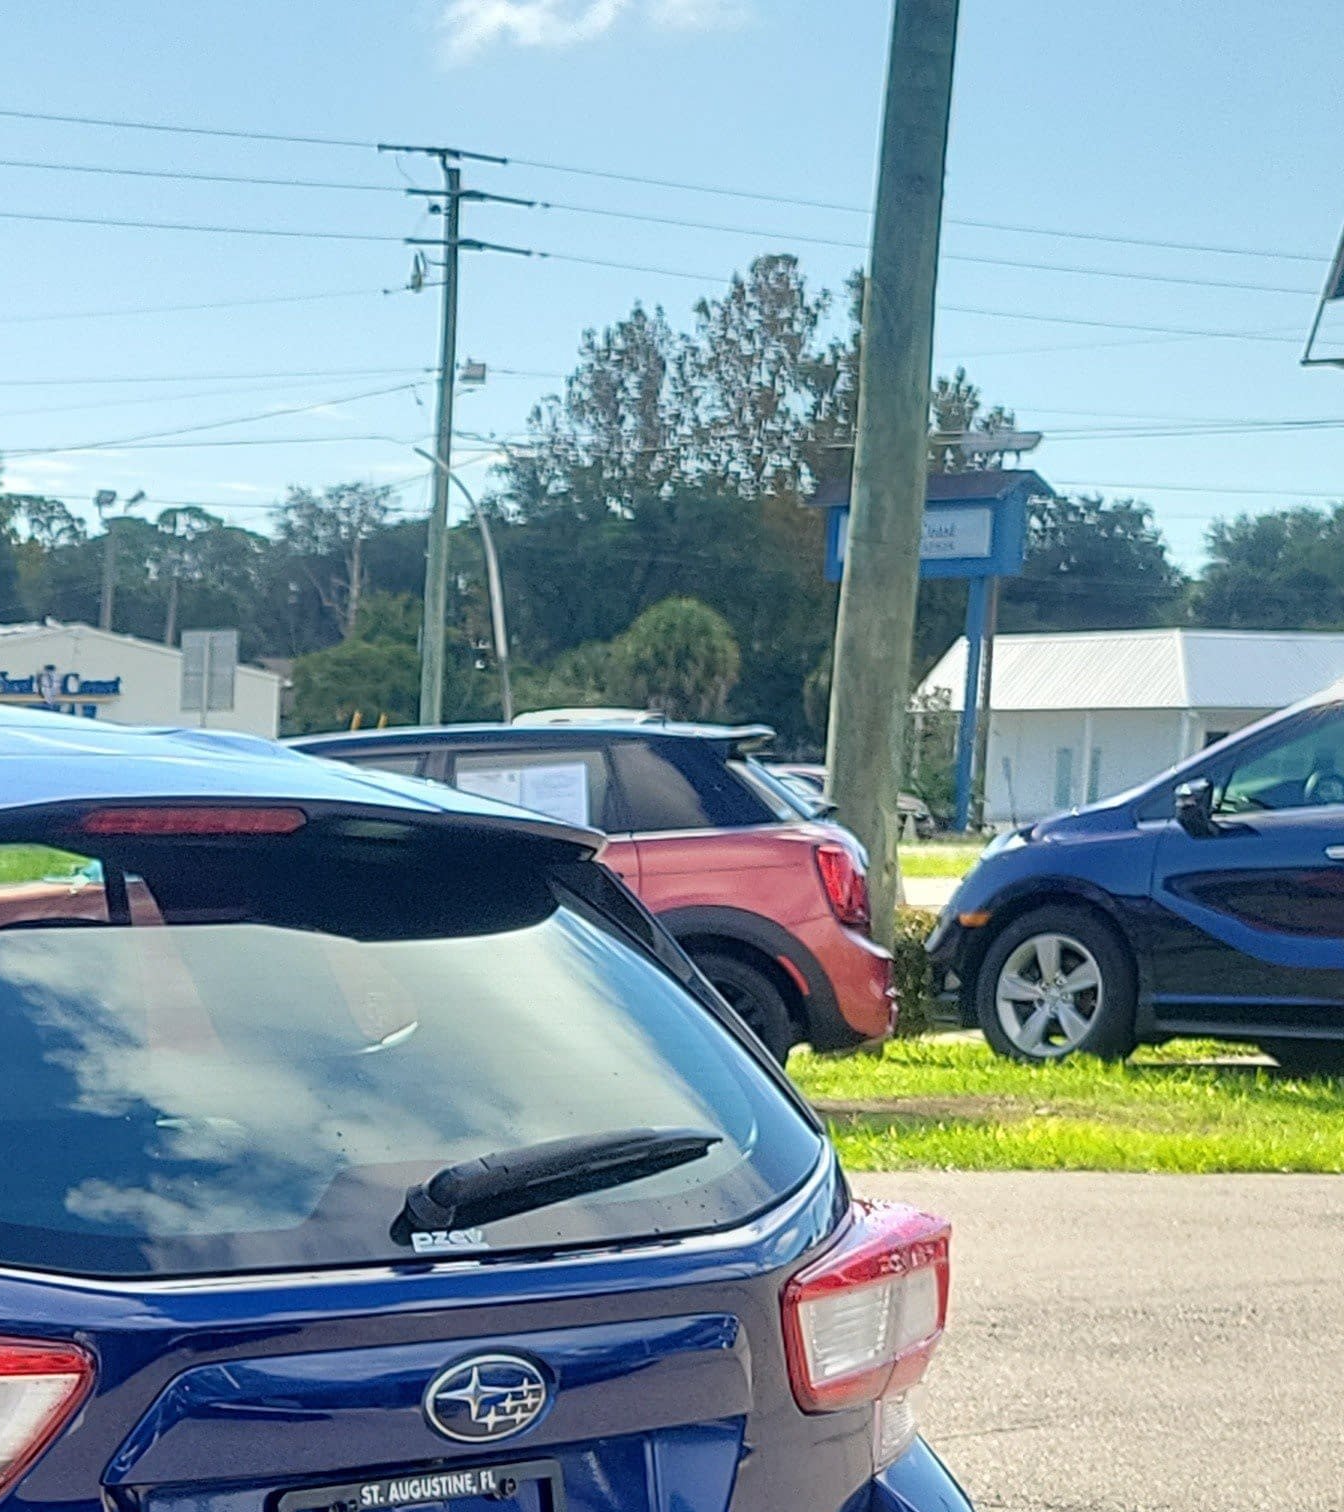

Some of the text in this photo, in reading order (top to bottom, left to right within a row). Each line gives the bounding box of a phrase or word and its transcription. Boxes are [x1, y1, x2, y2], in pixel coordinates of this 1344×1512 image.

[359, 1470, 498, 1506] ST. AUGUSTINE, FL
